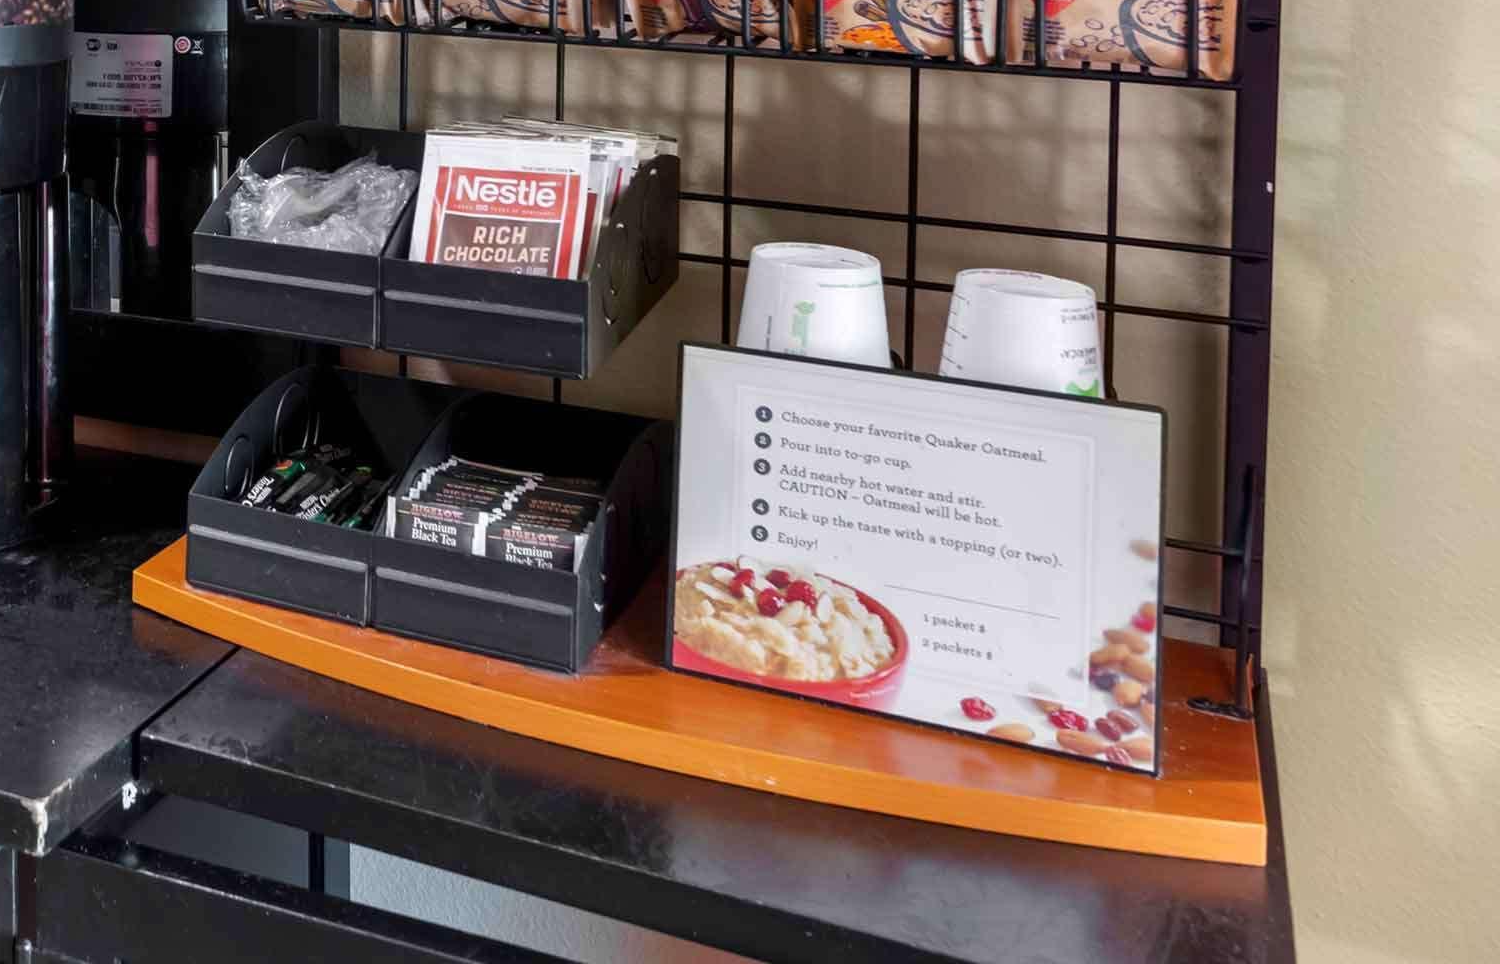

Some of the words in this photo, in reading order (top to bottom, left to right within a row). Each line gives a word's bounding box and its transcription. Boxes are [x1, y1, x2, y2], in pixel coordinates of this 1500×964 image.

[473, 226, 527, 244] RICH
[443, 247, 551, 263] CHOCOLATE
[781, 412, 830, 429] Choose
[833, 421, 864, 434] your
[868, 424, 922, 444] favorite
[925, 434, 977, 452] Quaker
[981, 442, 1047, 463] Oatmeal.
[781, 438, 811, 453] Pour
[815, 444, 841, 457] into
[845, 449, 881, 464] to-go
[884, 456, 912, 470] cup.
[780, 464, 806, 478] Add
[810, 471, 855, 489] nearby
[860, 476, 882, 491] hot
[886, 483, 924, 498] water
[928, 491, 953, 504] and
[958, 496, 986, 509] stir.
[780, 479, 848, 501] CAUTION
[863, 494, 921, 514] Oatmeal
[925, 506, 950, 519] will
[954, 508, 971, 522] be
[975, 512, 1003, 528] hot.
[413, 517, 457, 536] Premium
[411, 528, 439, 544] Black
[440, 533, 457, 547] Tea
[777, 532, 818, 550] Enjoy!
[778, 506, 808, 521] Kick
[812, 515, 828, 527] up
[833, 516, 854, 529] the
[858, 522, 891, 537] taste
[895, 528, 924, 543] with
[929, 535, 936, 544] a
[940, 536, 995, 557] topping
[1000, 543, 1021, 560] (or
[1025, 551, 1062, 568] two).
[506, 541, 553, 559] Premium
[932, 616, 975, 632] packet
[932, 642, 982, 658] packets
